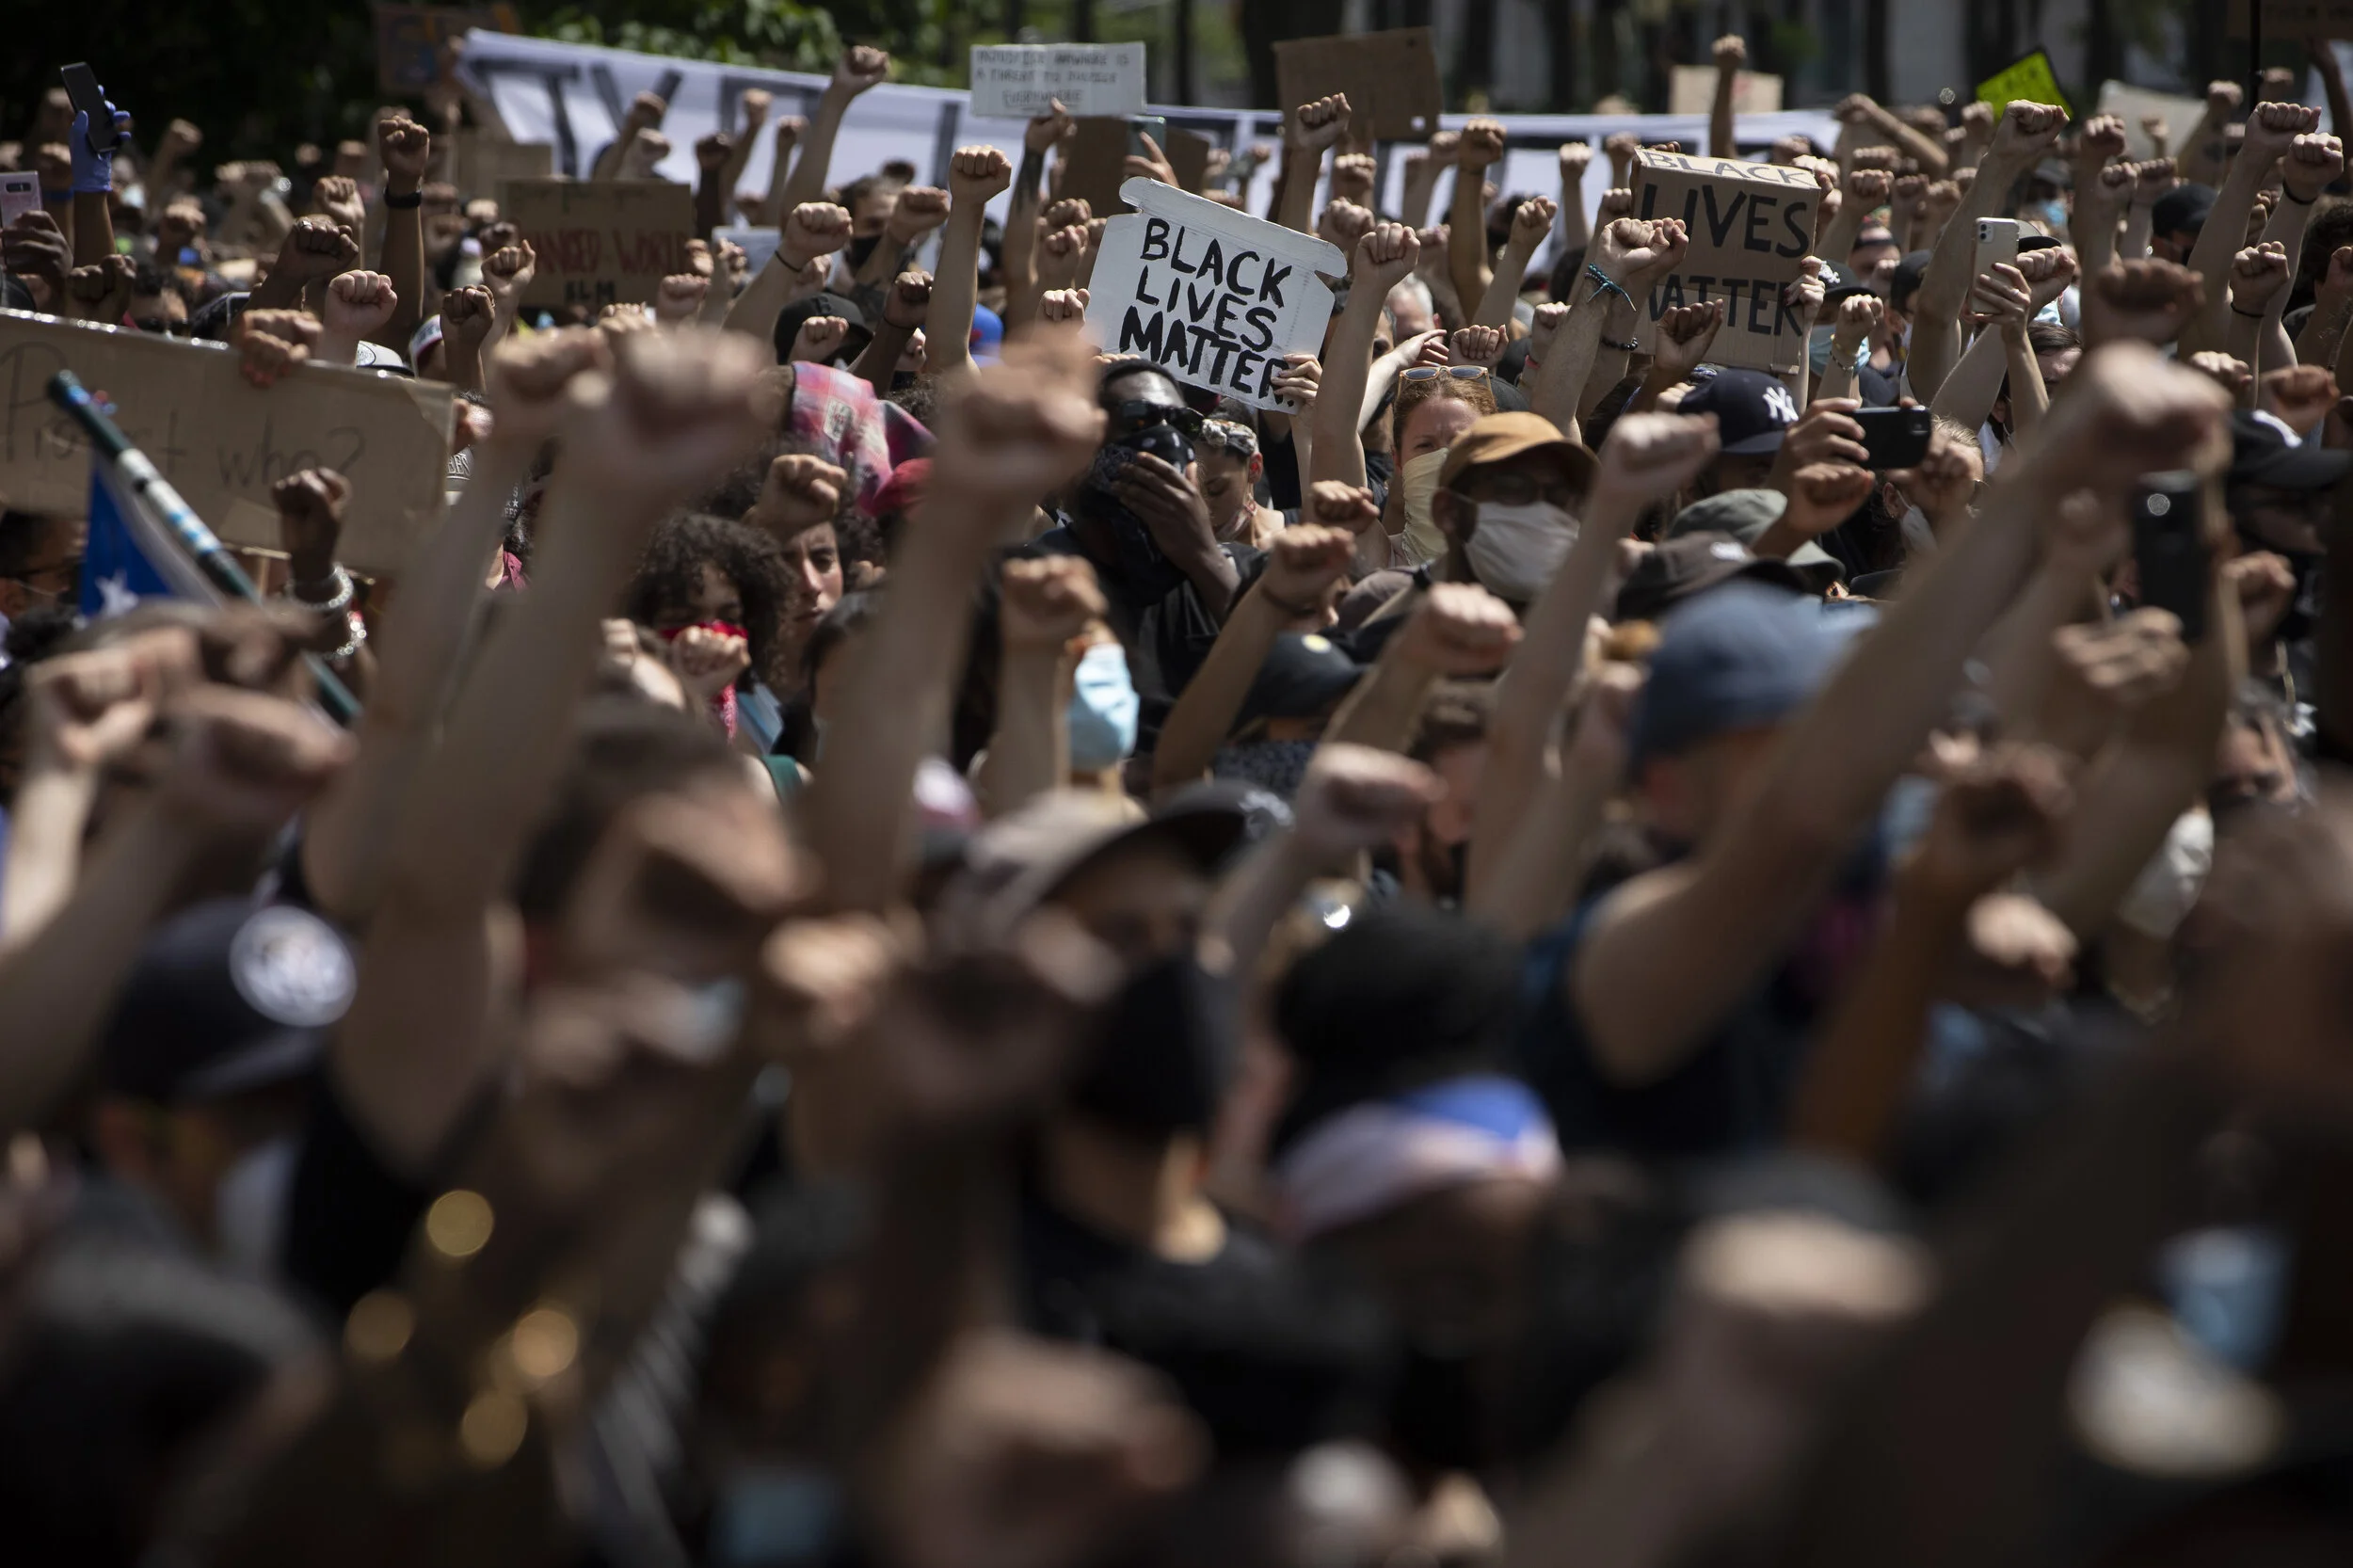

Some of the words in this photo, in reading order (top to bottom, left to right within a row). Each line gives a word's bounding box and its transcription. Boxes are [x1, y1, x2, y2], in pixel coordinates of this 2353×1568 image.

[1044, 72, 1061, 84] TO
[1642, 151, 1819, 187] BLACK
[1140, 217, 1292, 309] BLACK
[1136, 264, 1277, 352] LIVES
